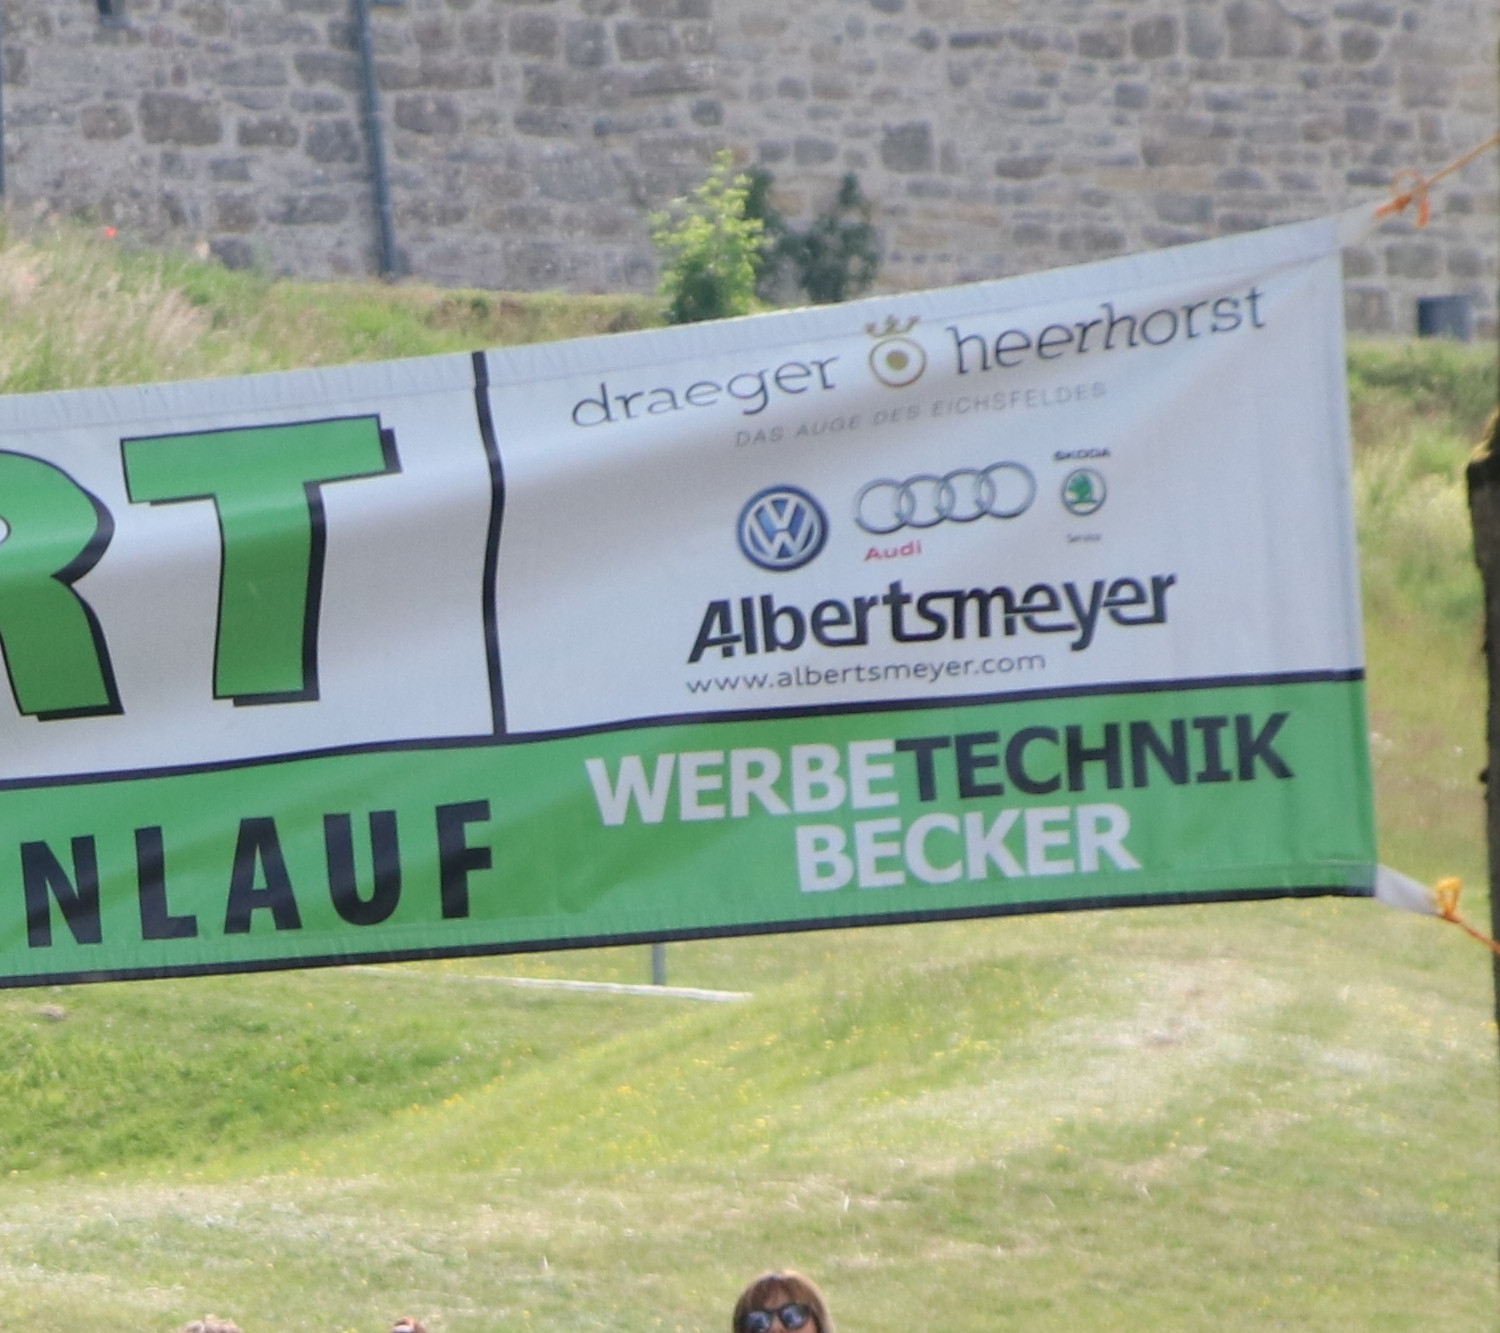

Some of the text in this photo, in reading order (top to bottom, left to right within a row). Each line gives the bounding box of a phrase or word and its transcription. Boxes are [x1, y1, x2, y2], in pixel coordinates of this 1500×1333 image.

[569, 285, 1267, 429] draeger heerhorst
[735, 426, 784, 447] DAS
[796, 416, 861, 438] AUGE
[872, 405, 920, 427] DES
[865, 540, 923, 562] Audi
[687, 572, 1178, 664] Albertsmeyer
[686, 651, 1047, 695] www.albertsmeyer.com
[585, 711, 1294, 828] WERBETECHNIK
[795, 803, 1142, 894] BECKER
